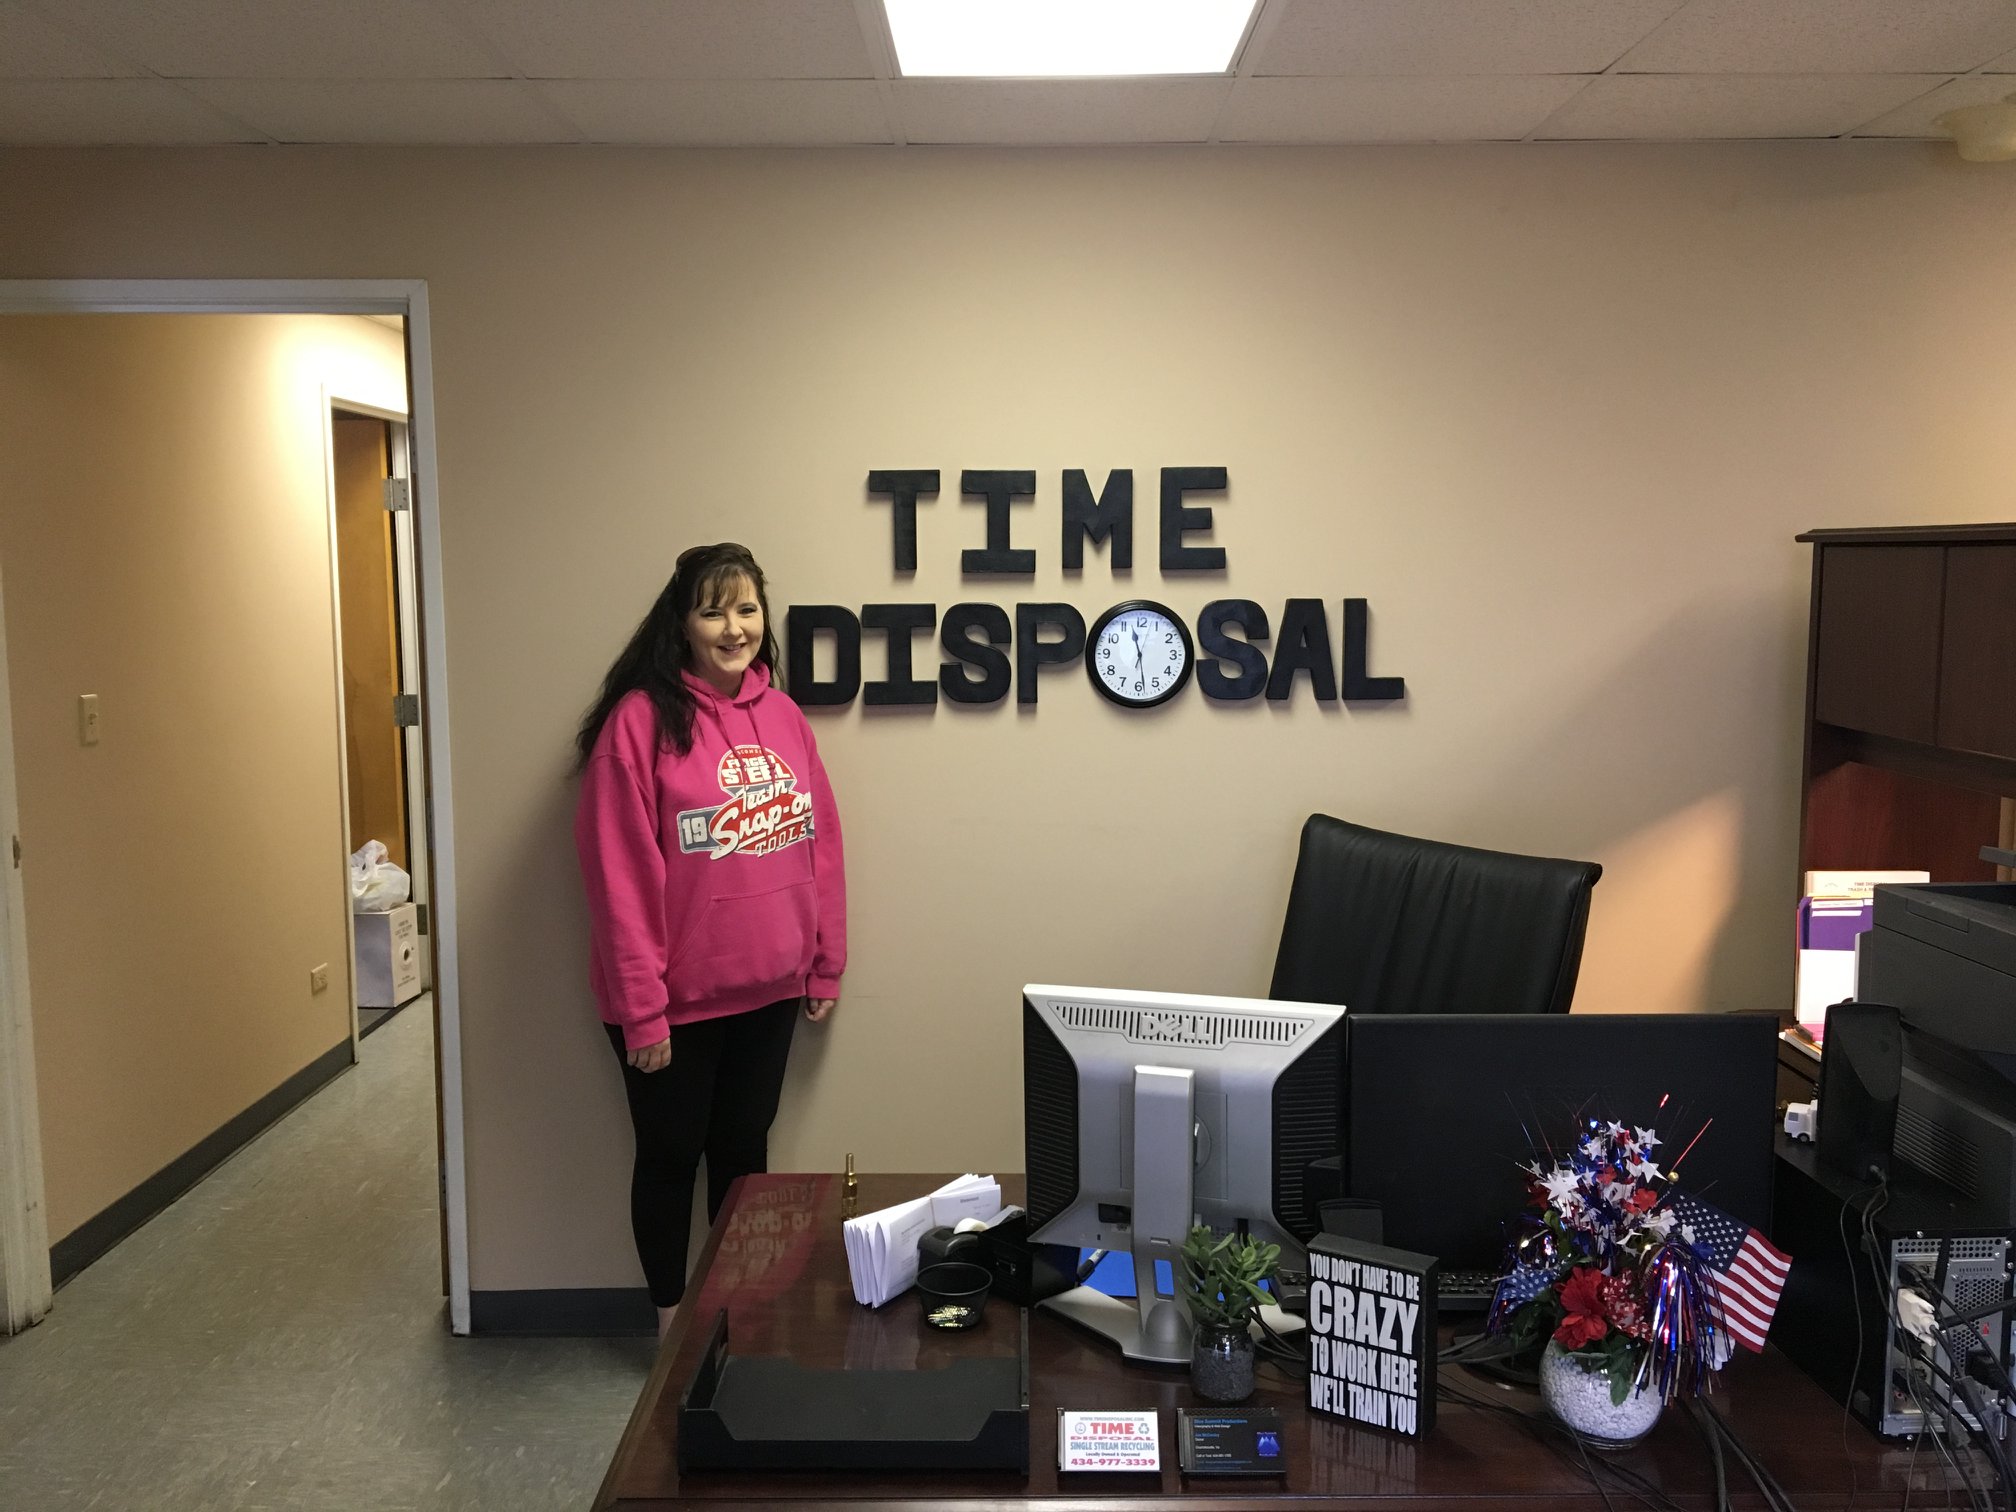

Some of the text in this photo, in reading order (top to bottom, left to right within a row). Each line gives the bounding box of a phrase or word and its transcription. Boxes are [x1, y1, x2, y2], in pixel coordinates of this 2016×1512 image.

[869, 467, 1227, 573] TIME
[1121, 621, 1127, 632] 11
[1136, 617, 1148, 628] 12
[1155, 621, 1159, 632] 1
[1108, 633, 1120, 644] 10
[1165, 633, 1173, 644] 2
[1102, 648, 1111, 659] 9
[1169, 649, 1178, 660] 3
[1107, 665, 1116, 676] 8
[1163, 665, 1172, 676] 4
[1119, 676, 1127, 687] 7
[1134, 681, 1143, 692] 6
[1151, 677, 1160, 688] 5
[682, 816, 708, 845] 19
[755, 822, 807, 857] TOOLS
[1140, 1015, 1211, 1041] DELL
[1309, 1252, 1420, 1301] YOU DON'T HAVE TO BE
[1309, 1280, 1419, 1355] CRAZY
[1310, 1334, 1418, 1398] TO WORK HERE
[1310, 1373, 1417, 1436] WE'LL TRAIN YOU
[1090, 1422, 1135, 1435] TIME
[1070, 1441, 1155, 1451] SINGLE STREAM RECYCLING
[1070, 1458, 1156, 1466] 434-977-3339
